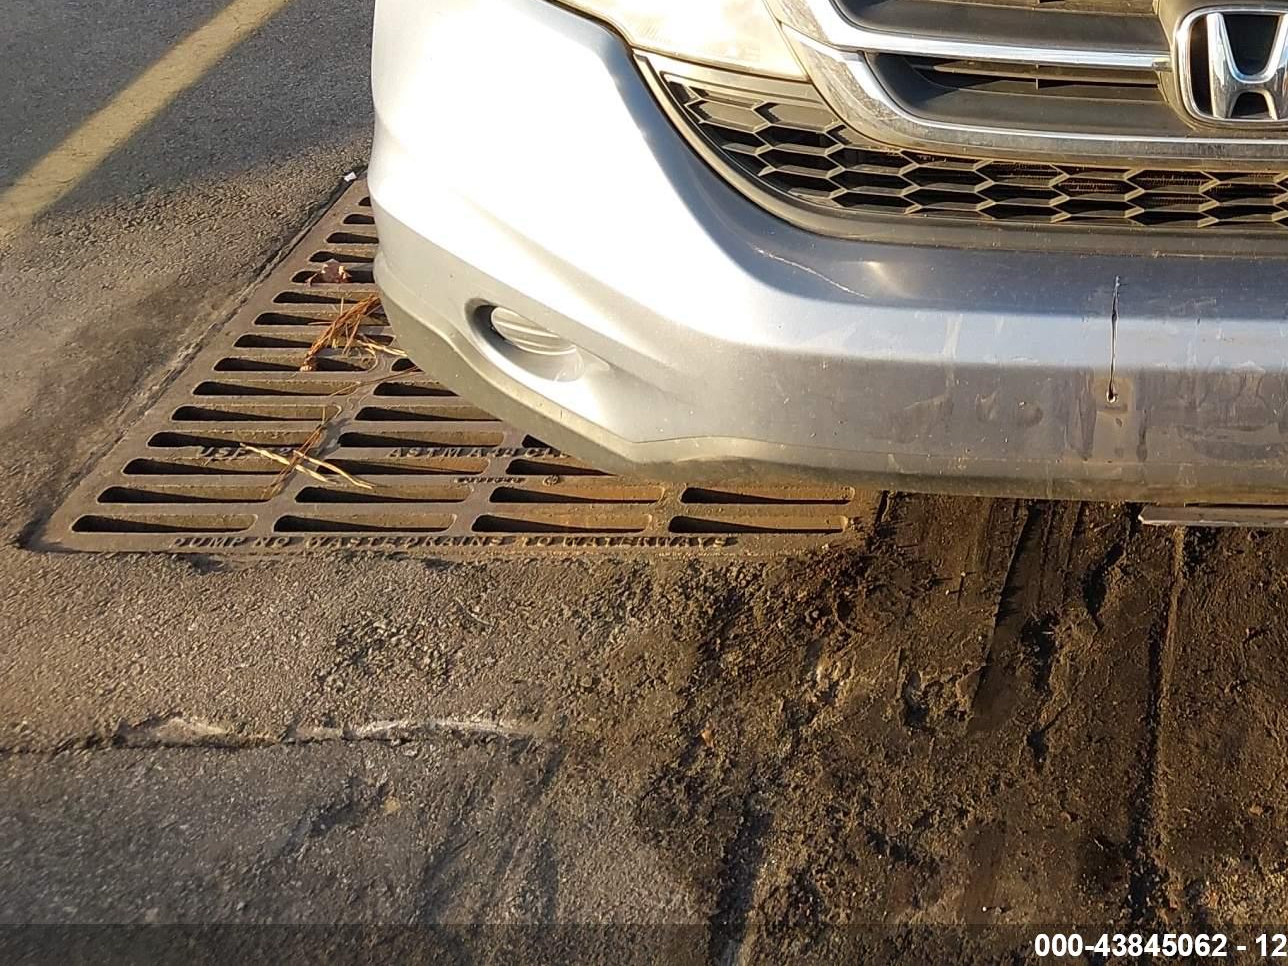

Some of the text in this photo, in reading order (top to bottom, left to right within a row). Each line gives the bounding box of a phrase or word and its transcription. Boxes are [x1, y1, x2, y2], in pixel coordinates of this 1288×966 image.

[167, 536, 246, 549] DUMP
[250, 536, 292, 549] NO
[304, 535, 399, 550] WASTE
[561, 535, 728, 549] WATERWAYS
